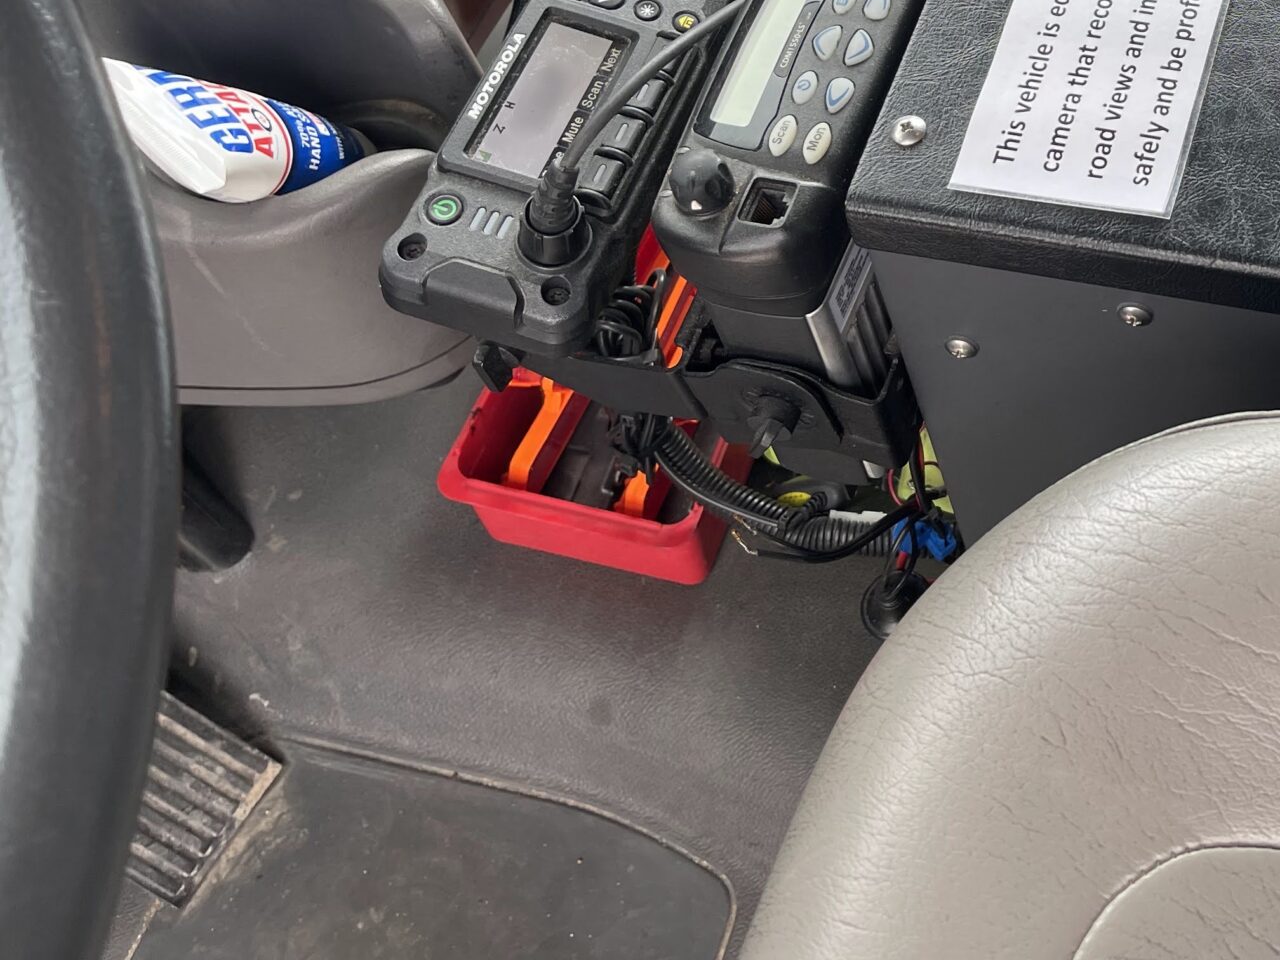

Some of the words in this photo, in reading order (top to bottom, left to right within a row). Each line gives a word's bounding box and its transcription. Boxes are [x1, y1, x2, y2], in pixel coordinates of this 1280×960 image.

[467, 32, 527, 120] MOTOROLA
[1160, 46, 1187, 72] be
[561, 116, 584, 143] Mute
[581, 80, 604, 110] Scan
[601, 48, 621, 72] Next
[993, 120, 1026, 165] This
[1014, 43, 1054, 114] vehicle
[1036, 21, 1061, 38] is
[1043, 92, 1083, 172] camera
[1067, 44, 1098, 87] that
[1087, 127, 1117, 179] road
[1103, 64, 1137, 122] views
[1125, 19, 1151, 58] and
[1153, 76, 1179, 116] and
[308, 125, 321, 171] HAND
[771, 119, 791, 145] Scan
[806, 126, 826, 152] Mon
[1132, 120, 1170, 187] safely
